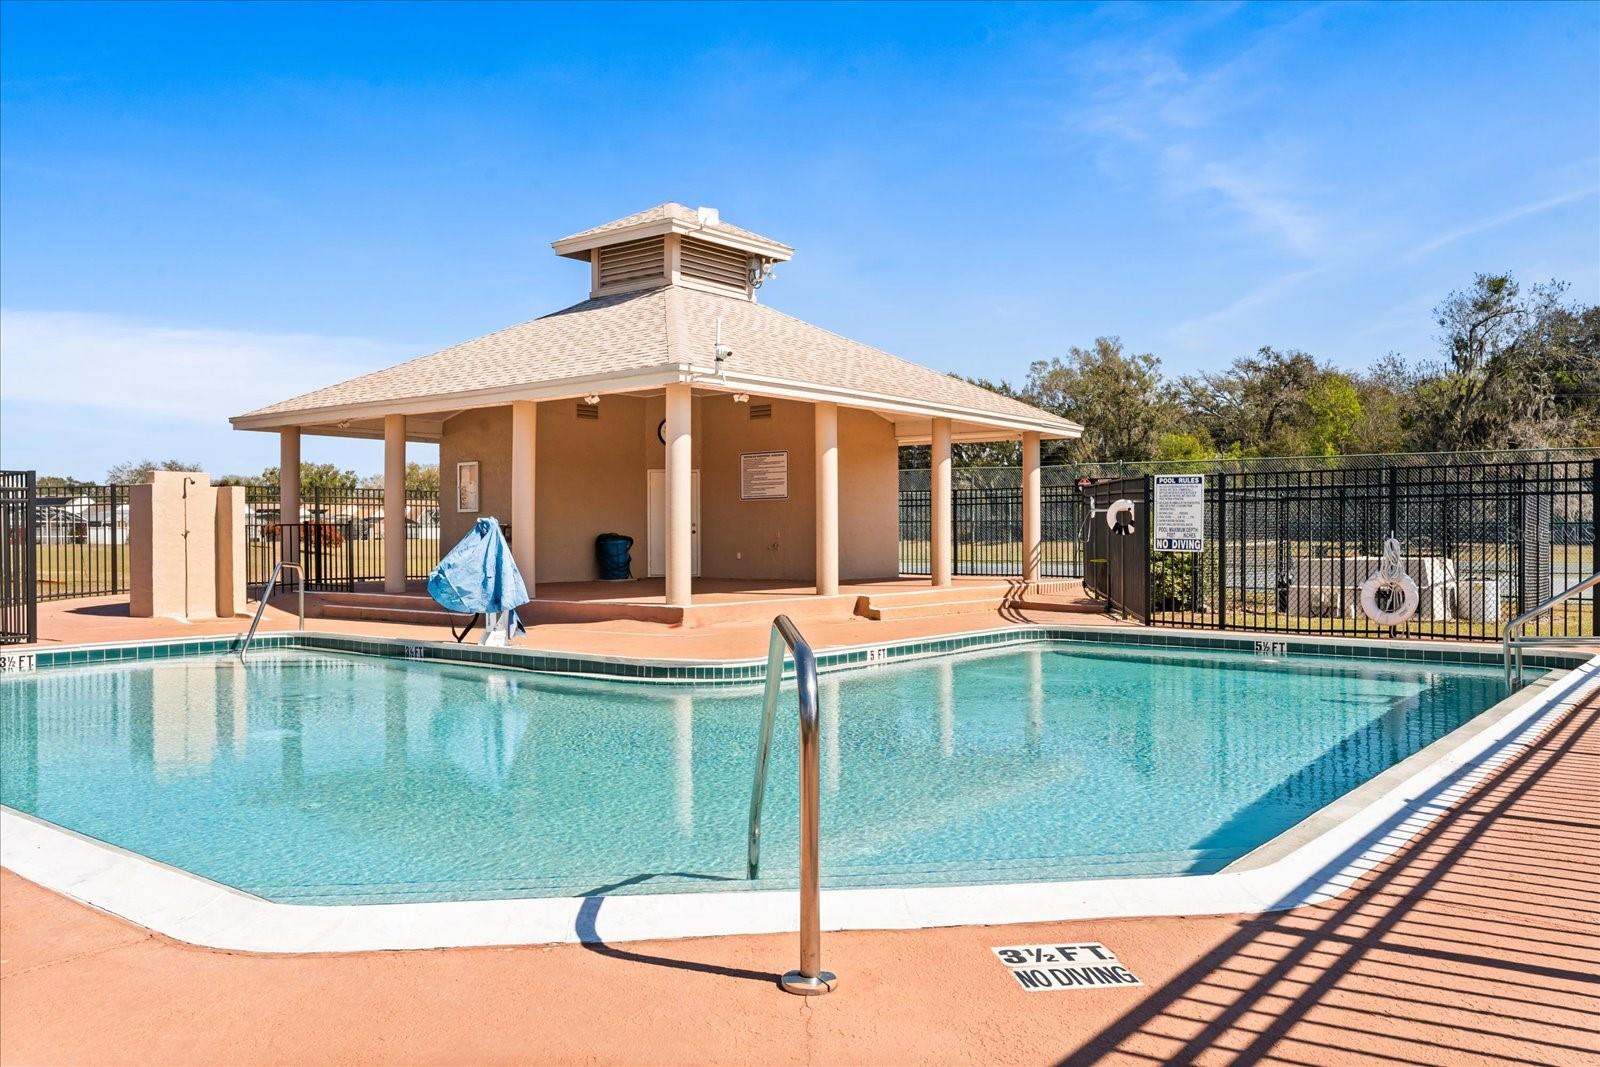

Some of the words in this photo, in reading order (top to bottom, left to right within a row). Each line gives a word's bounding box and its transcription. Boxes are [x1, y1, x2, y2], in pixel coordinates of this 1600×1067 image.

[1156, 540, 1169, 549] NO
[1171, 540, 1201, 550] DIVING
[870, 650, 875, 660] 5
[1055, 945, 1114, 962] FT.
[1013, 969, 1052, 988] NO
[1048, 966, 1139, 986] DIVING
